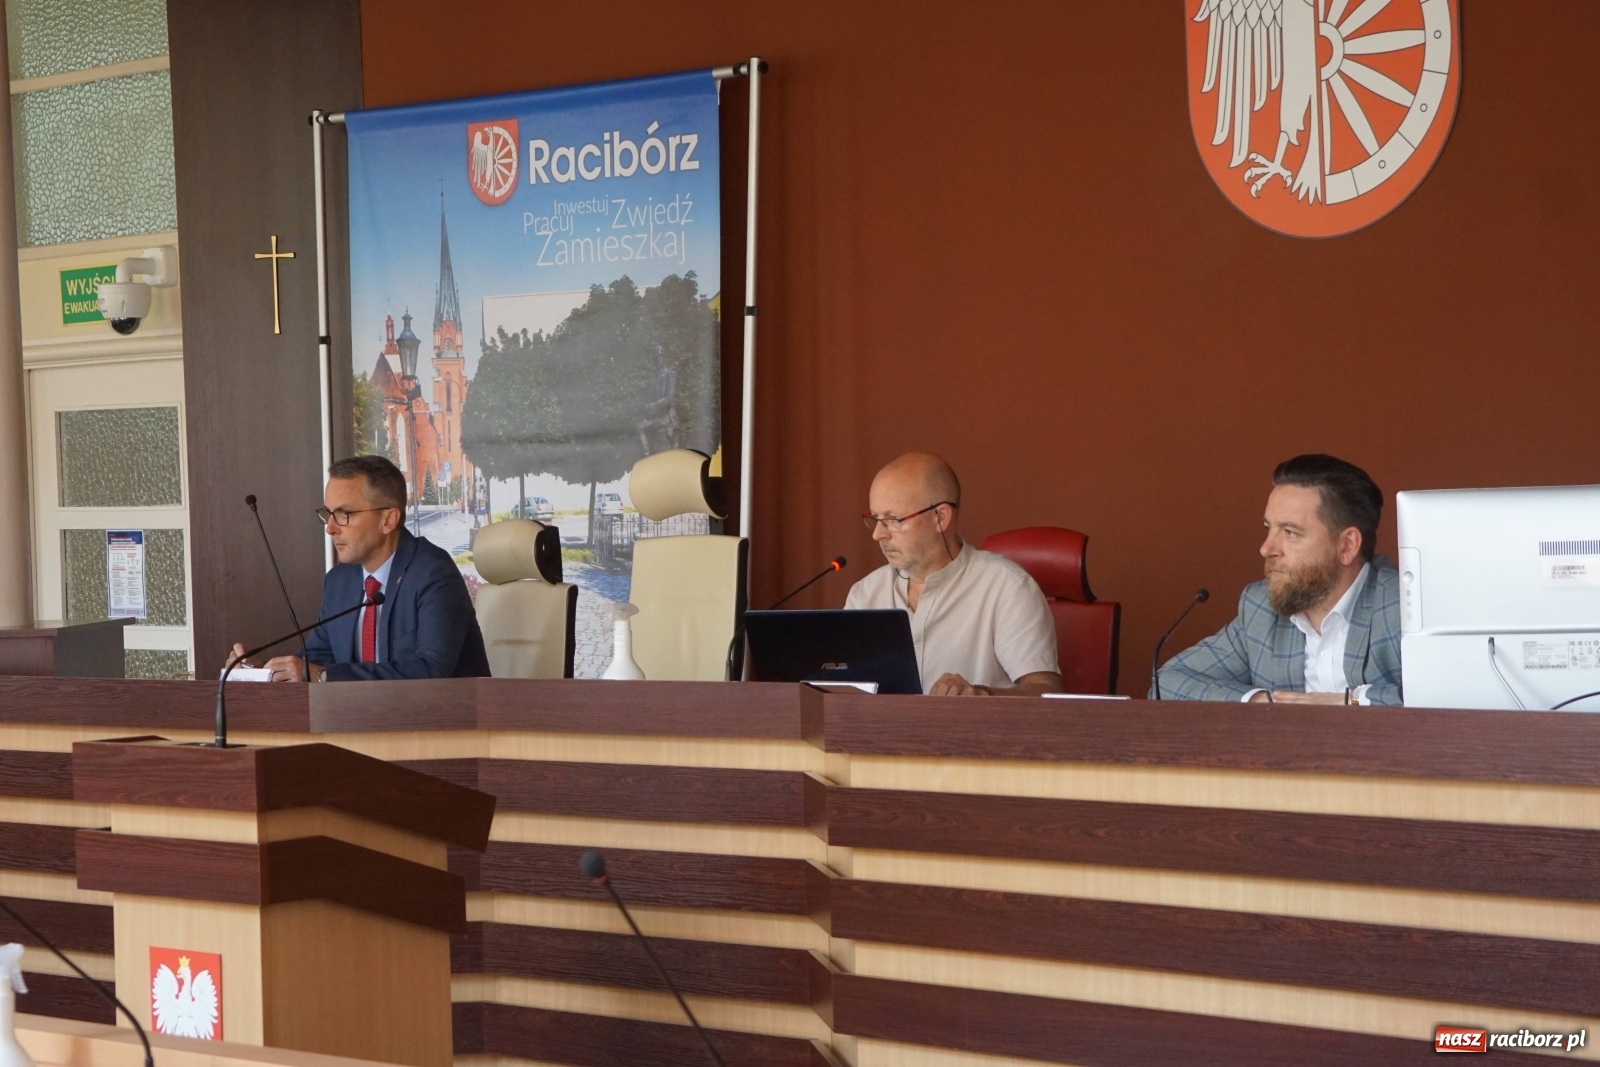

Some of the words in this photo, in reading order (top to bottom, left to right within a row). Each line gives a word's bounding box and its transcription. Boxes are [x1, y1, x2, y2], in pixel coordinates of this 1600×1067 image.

[529, 120, 700, 185] Racibórz
[553, 194, 609, 216] Inwestuj
[611, 192, 694, 229] Zwiedź
[523, 212, 574, 236] Pracuj
[536, 220, 686, 266] Zamieszkaj
